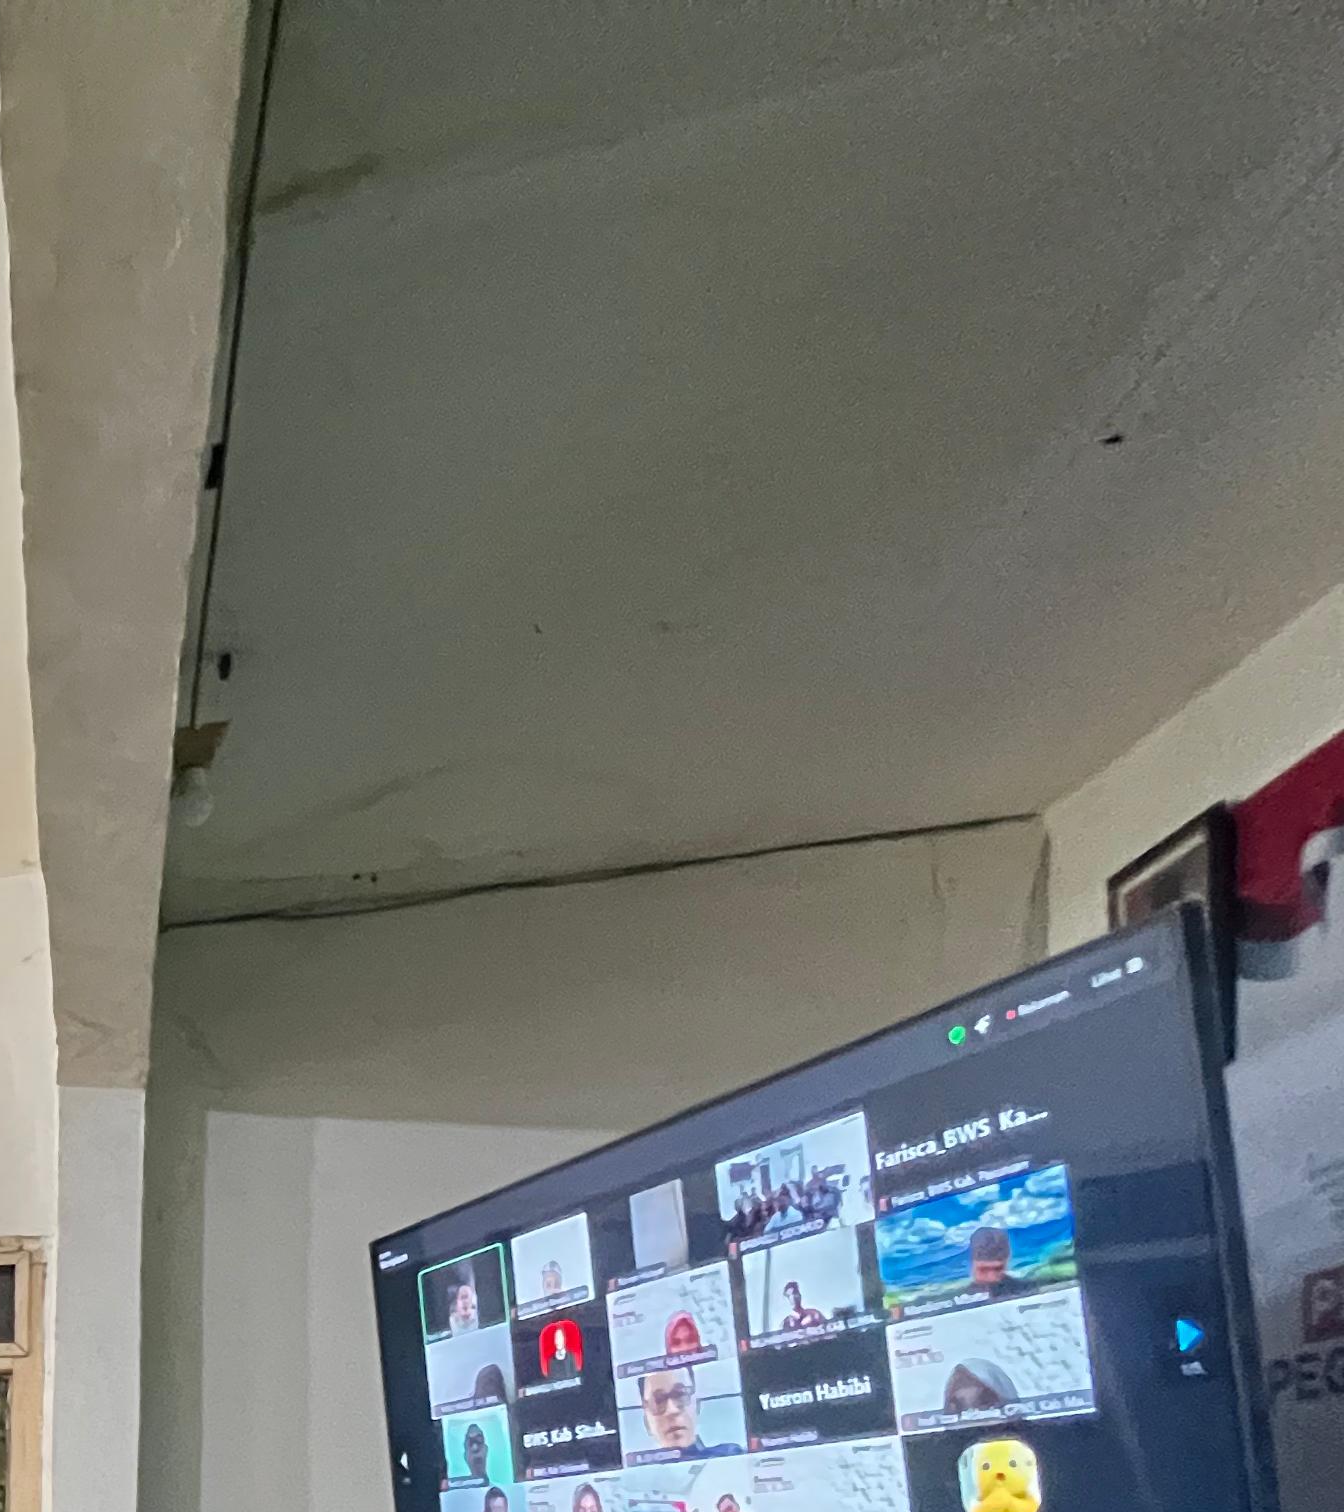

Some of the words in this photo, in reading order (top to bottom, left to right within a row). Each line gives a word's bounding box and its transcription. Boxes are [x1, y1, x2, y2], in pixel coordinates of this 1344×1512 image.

[874, 1117, 991, 1170] Farisca_BWS
[758, 1390, 814, 1410] Yusron
[814, 1375, 872, 1401] Habibi
